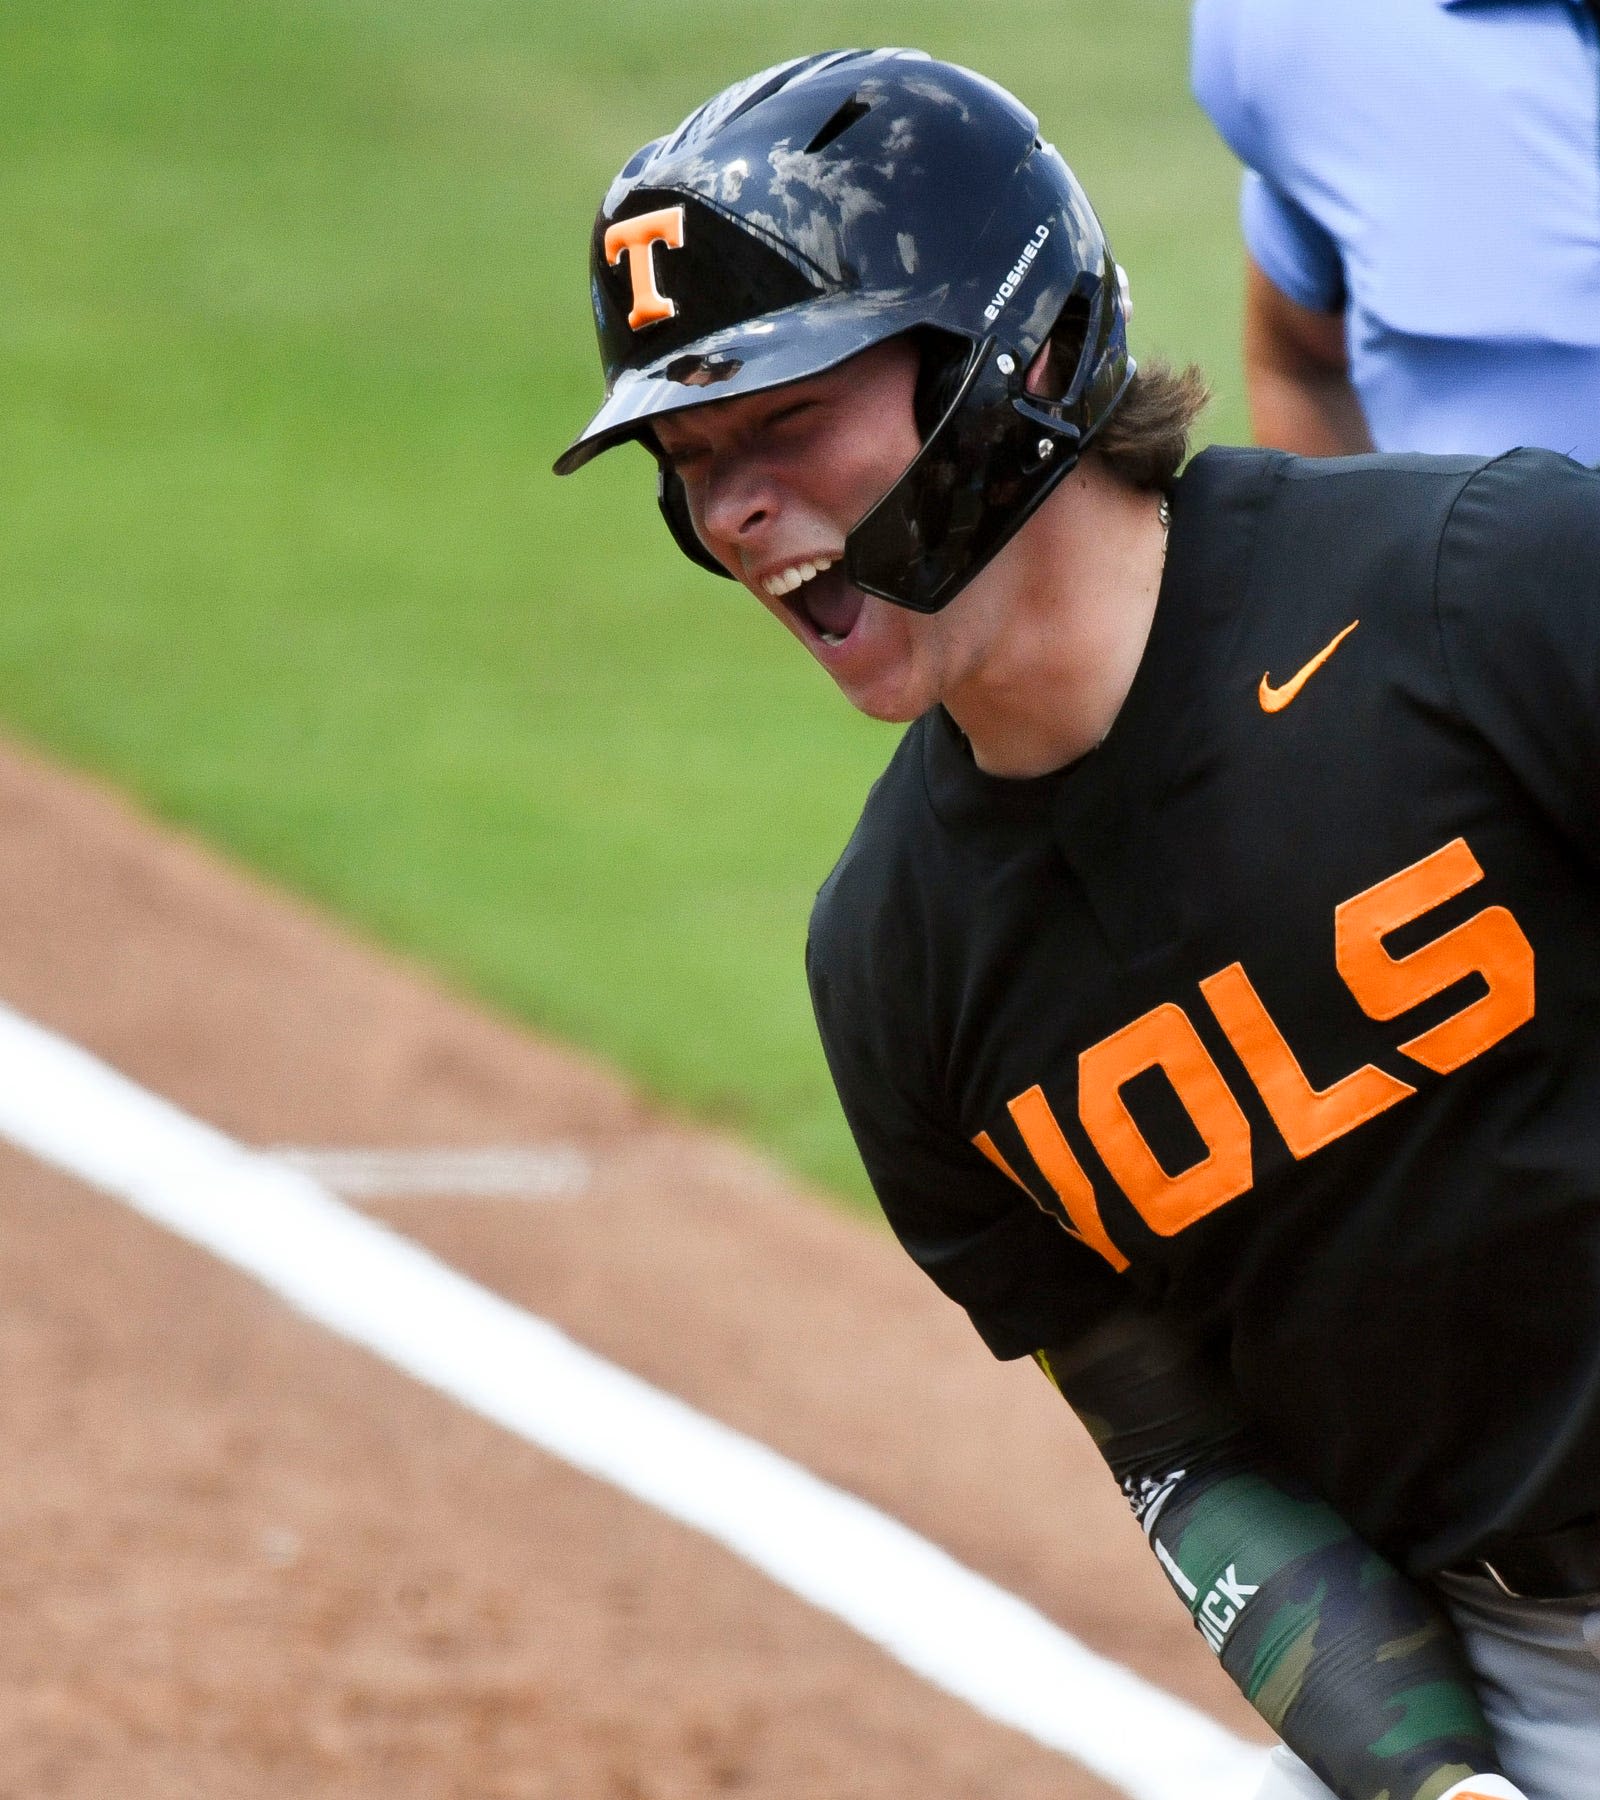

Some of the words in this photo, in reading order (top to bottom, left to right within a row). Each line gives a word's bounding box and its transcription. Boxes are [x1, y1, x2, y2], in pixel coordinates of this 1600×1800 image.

[605, 204, 685, 332] T
[984, 224, 1050, 321] EVOSHIELD
[972, 836, 1535, 1273] VOLS
